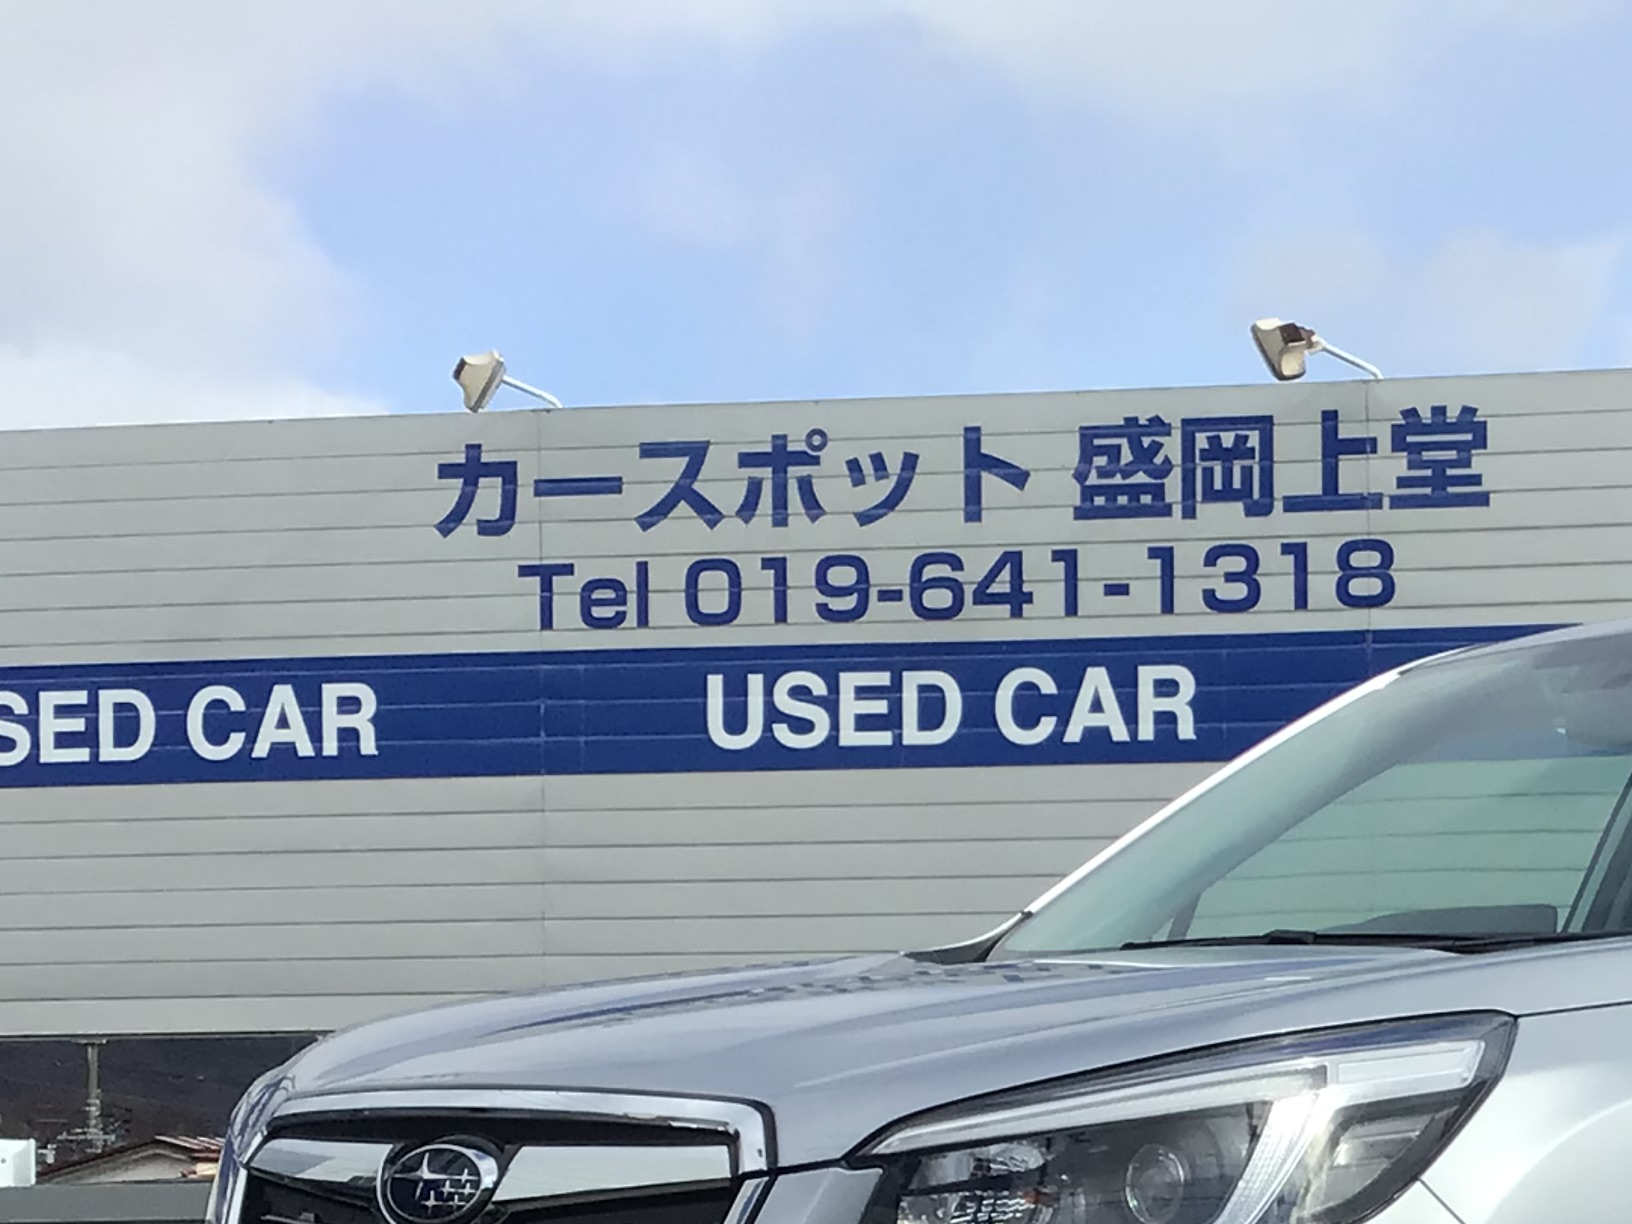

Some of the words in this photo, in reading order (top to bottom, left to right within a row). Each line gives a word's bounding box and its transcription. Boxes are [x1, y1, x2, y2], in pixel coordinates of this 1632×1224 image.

[435, 426, 1030, 538] カースポット
[1073, 404, 1490, 521] 盛岡上堂
[518, 561, 649, 630] Tel
[684, 538, 1396, 626] 019-641-1318
[186, 682, 378, 761] CAR
[707, 670, 962, 750] USED
[995, 665, 1197, 745] CAR
